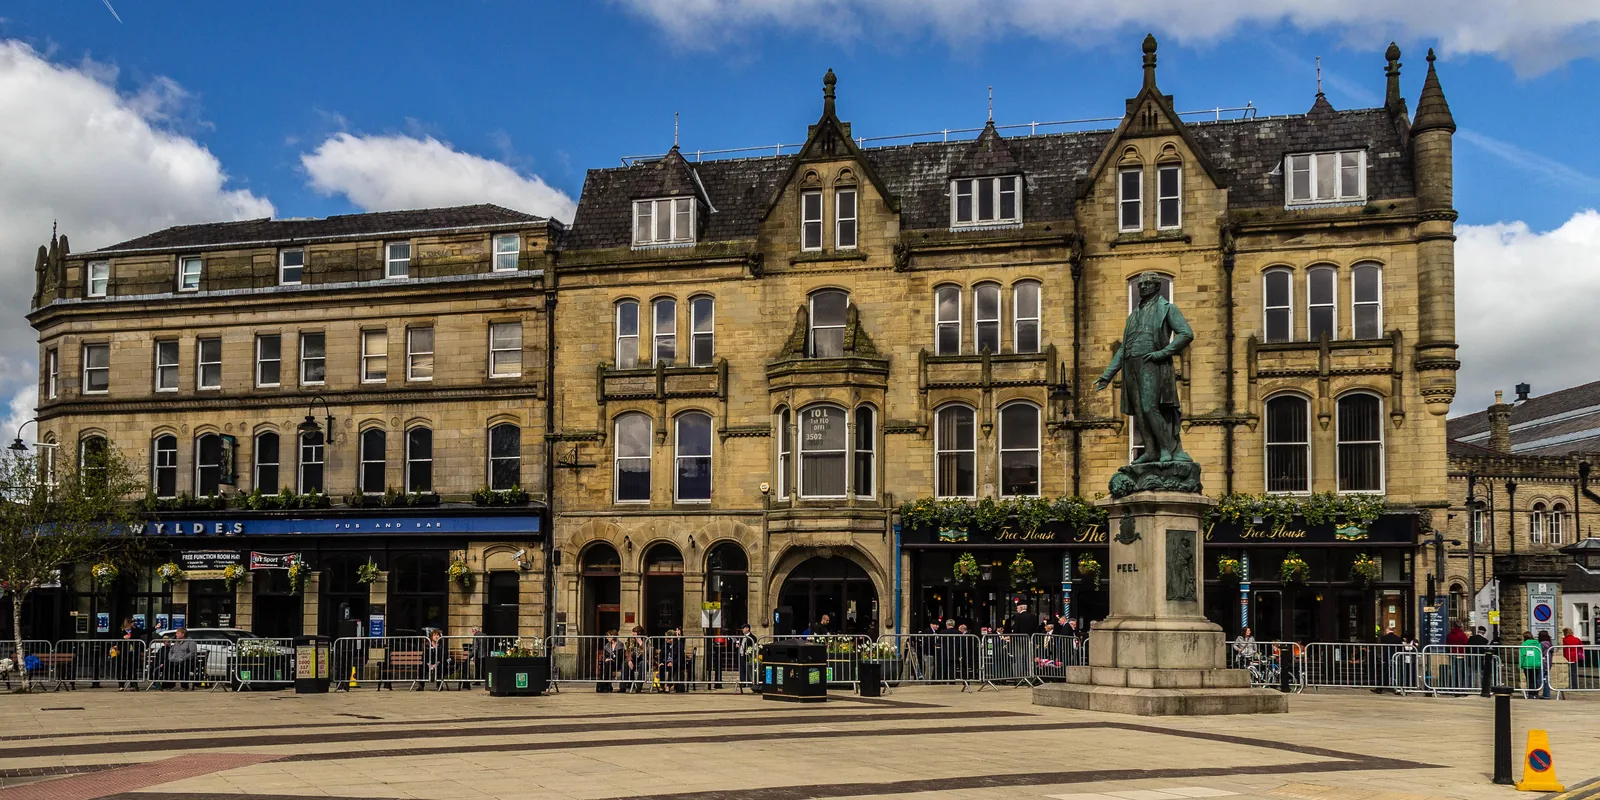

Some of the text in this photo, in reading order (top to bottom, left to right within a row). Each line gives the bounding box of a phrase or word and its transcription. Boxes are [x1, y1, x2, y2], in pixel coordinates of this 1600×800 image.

[129, 522, 242, 534] WYLDES
[994, 523, 1107, 542] Free House The
[1239, 524, 1306, 539] Free House
[1117, 563, 1138, 572] PEEL
